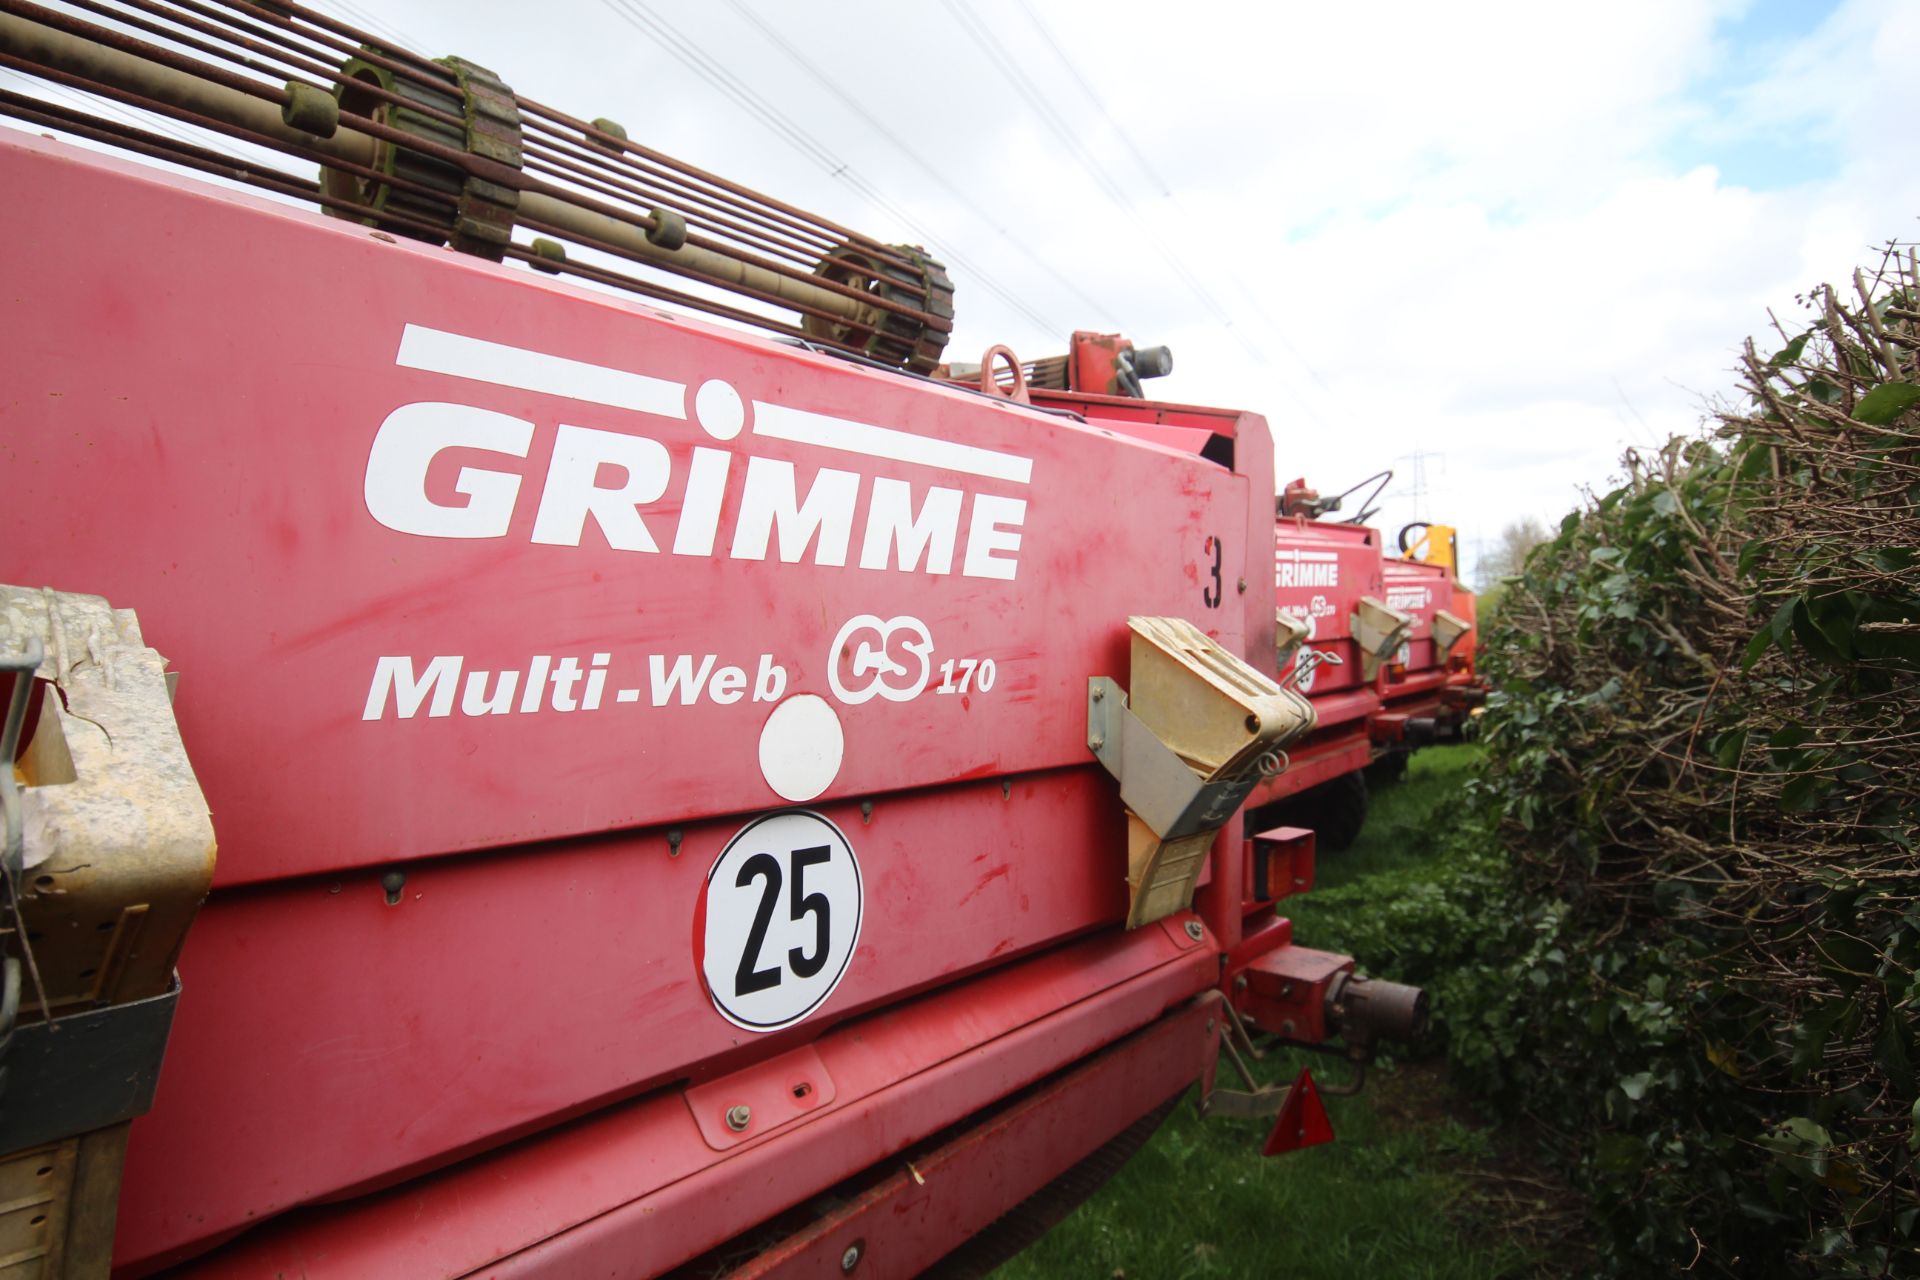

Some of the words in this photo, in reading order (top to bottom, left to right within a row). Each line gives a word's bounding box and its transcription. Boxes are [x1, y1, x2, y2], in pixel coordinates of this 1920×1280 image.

[1203, 535, 1222, 609] 3
[362, 653, 787, 720] Multi-Web
[828, 615, 934, 705] CS
[937, 658, 997, 695] 170
[735, 845, 831, 998] 25
